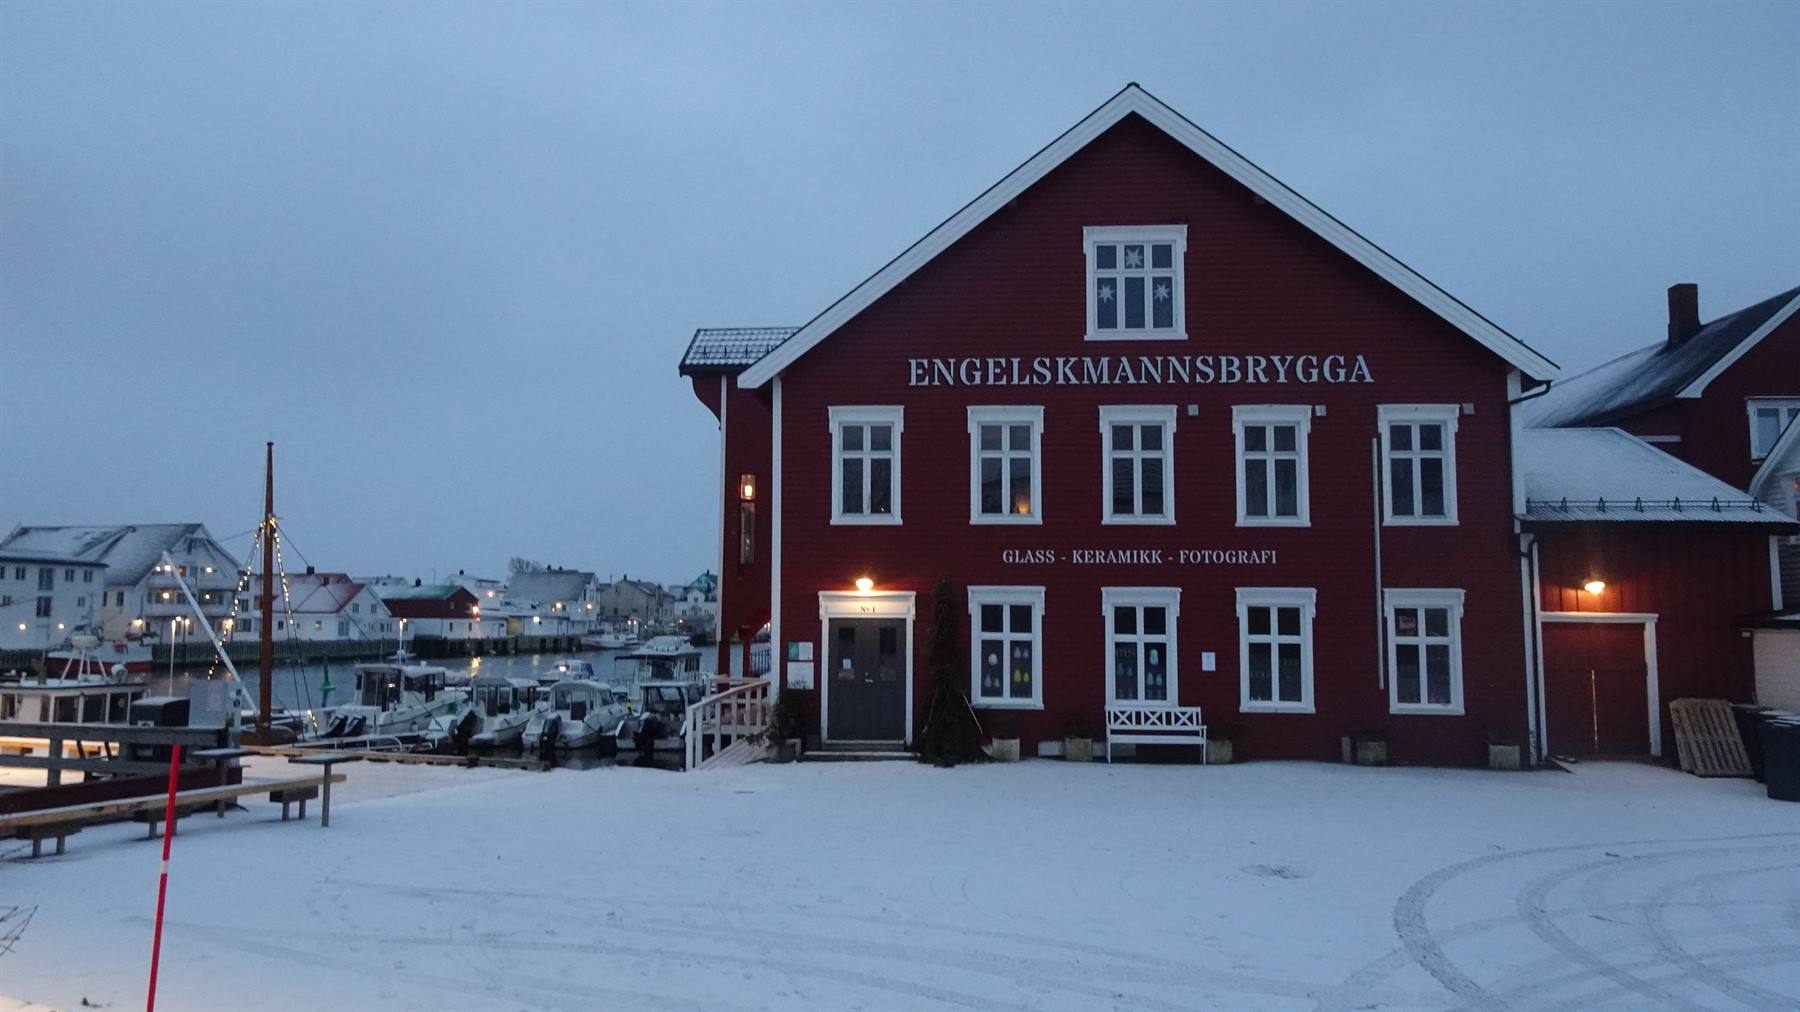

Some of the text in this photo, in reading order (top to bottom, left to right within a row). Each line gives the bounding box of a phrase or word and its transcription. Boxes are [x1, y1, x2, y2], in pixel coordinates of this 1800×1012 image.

[908, 355, 1374, 386] ENGELSKMANNSBRYGGA
[1002, 549, 1055, 564] GLASS
[1072, 549, 1163, 564] KERAMIKK
[1179, 549, 1277, 564] FOTOGRAFI
